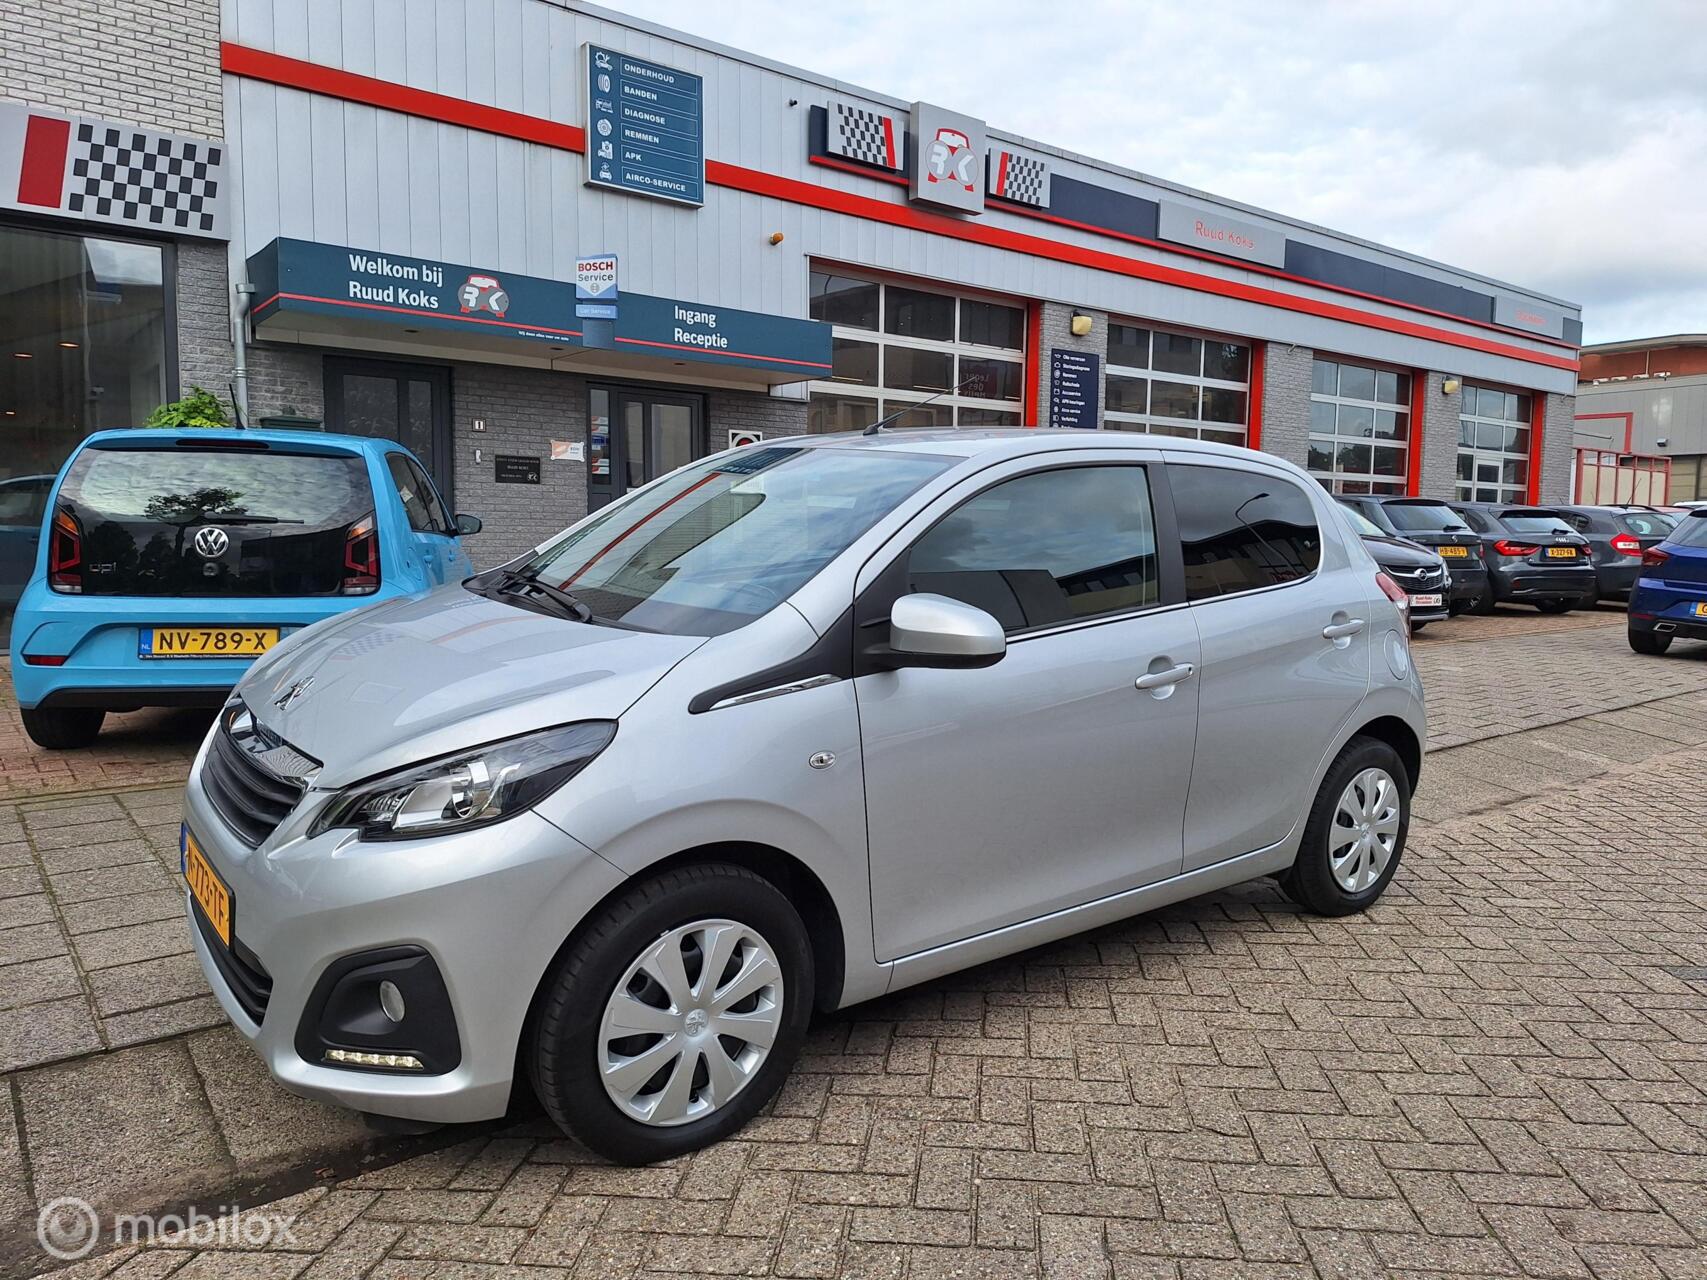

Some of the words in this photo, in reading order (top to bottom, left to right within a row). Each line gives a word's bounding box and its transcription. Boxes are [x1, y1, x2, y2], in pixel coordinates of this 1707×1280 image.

[624, 63, 675, 84] ONDERHOUD
[624, 85, 658, 101] BANDEN
[624, 107, 666, 125] DIAGNOSE
[624, 129, 660, 144] REMMEN
[625, 151, 643, 162] APK
[625, 172, 687, 192] AIRCO-SERVICE
[349, 254, 419, 282] Welkom
[422, 264, 443, 288] bij
[578, 261, 613, 272] BOSCH
[578, 273, 614, 282] Service
[349, 281, 394, 304] Ruud
[398, 287, 439, 309] Koks
[674, 305, 717, 328] Ingang
[674, 327, 728, 349] Receptie
[159, 631, 267, 651] NV-789-X
